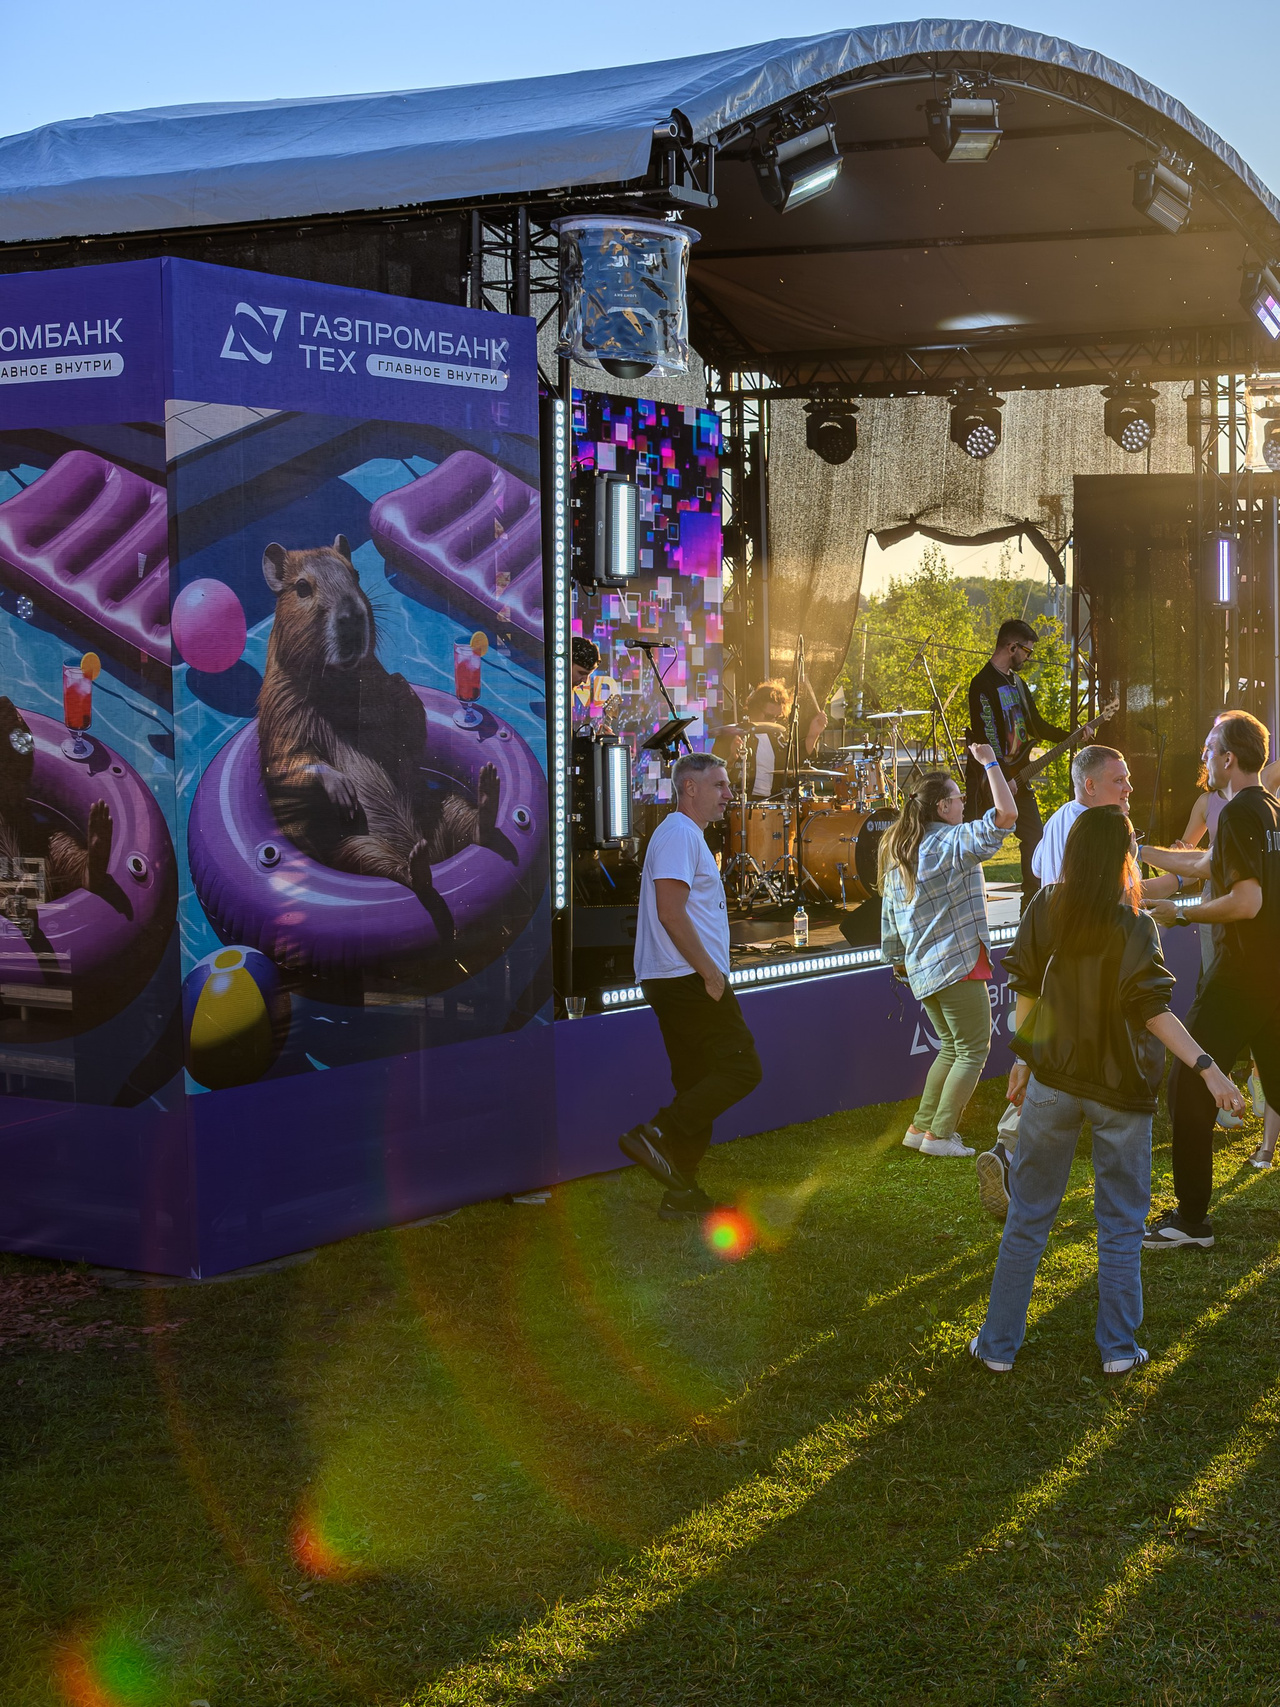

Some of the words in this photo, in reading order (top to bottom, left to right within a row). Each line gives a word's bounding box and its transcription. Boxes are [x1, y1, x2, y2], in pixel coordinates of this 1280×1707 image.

[300, 311, 508, 363] ГАЗПРОМБАНК
[55, 359, 113, 375] ВНУТРИ
[298, 343, 357, 375] ТЕХ
[377, 360, 441, 379] ГЛАВНОЕ
[447, 369, 499, 386] ВНУТРИ
